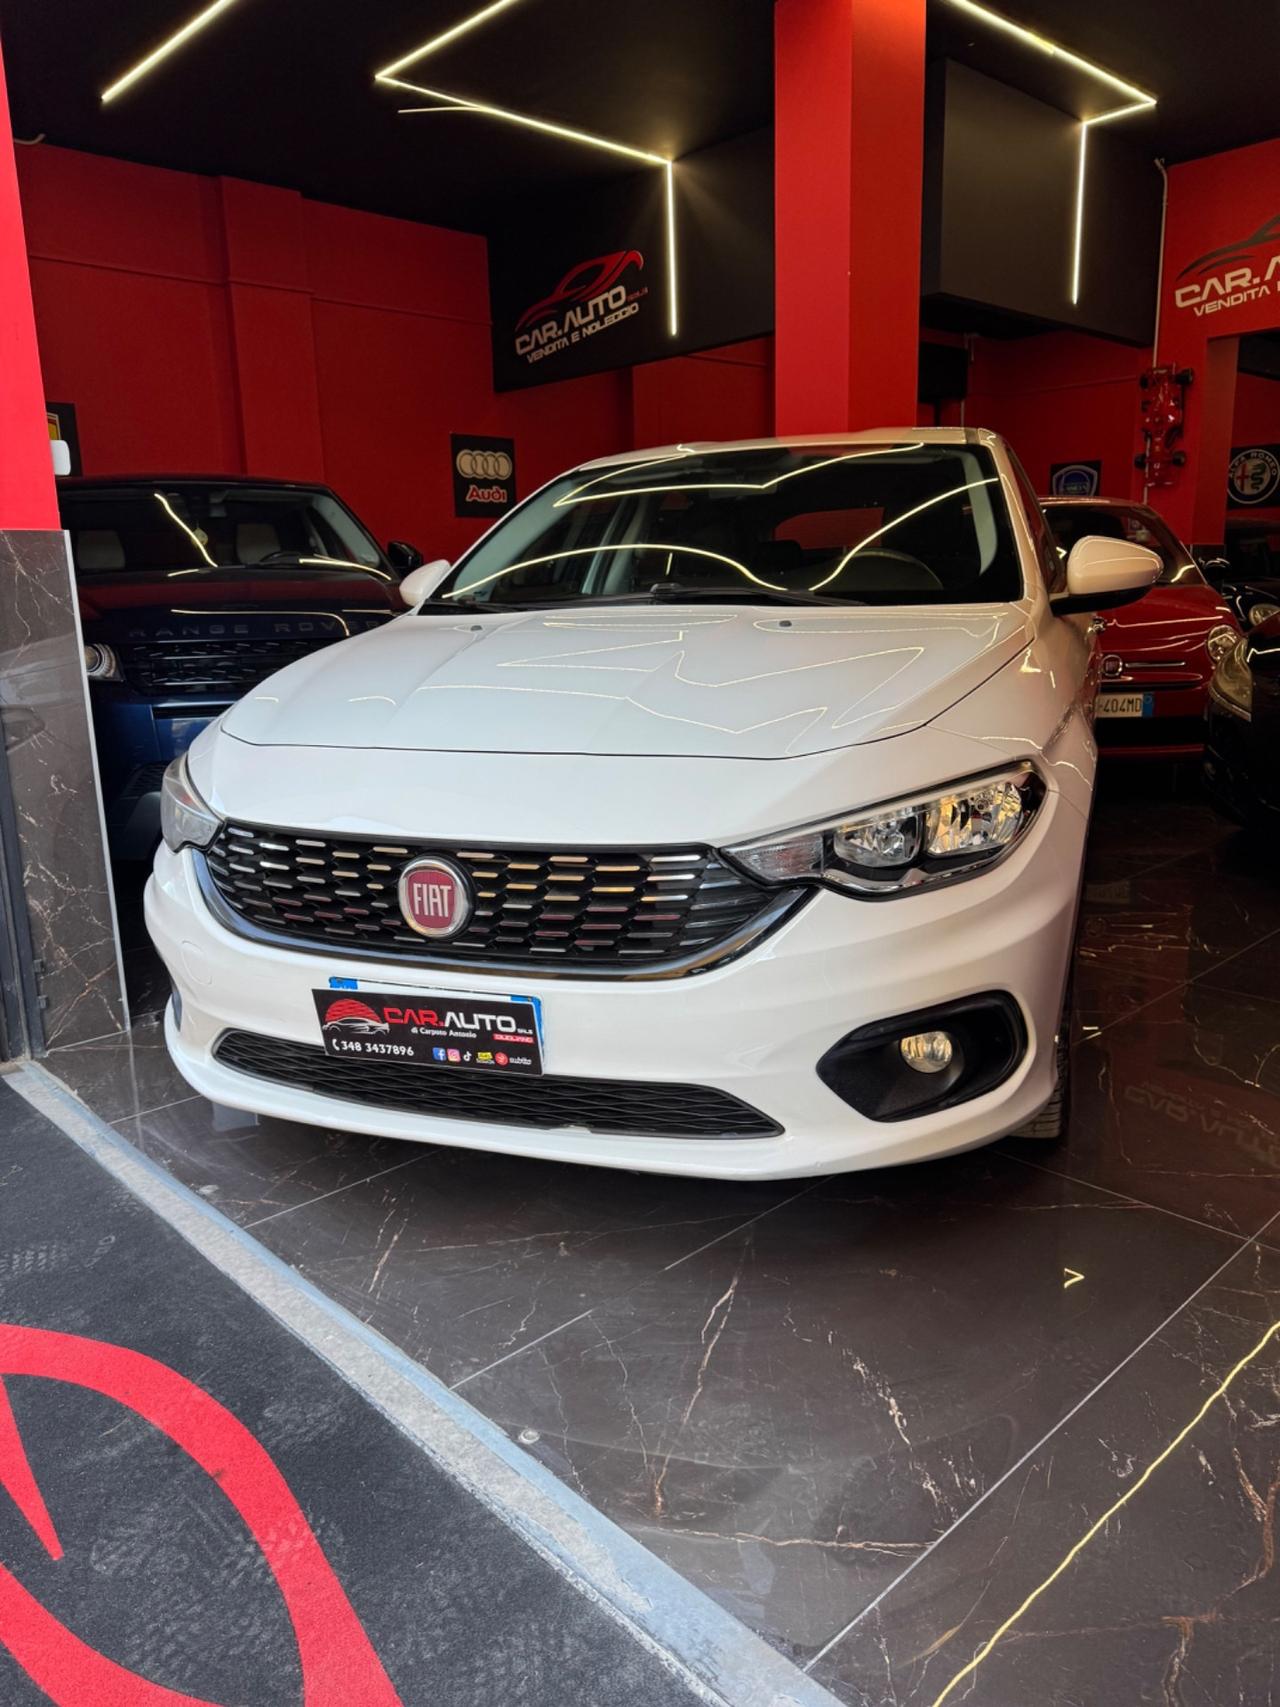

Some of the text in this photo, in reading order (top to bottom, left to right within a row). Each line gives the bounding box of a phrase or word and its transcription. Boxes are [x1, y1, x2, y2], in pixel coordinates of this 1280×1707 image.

[1193, 285, 1271, 317] VENDITA
[515, 285, 626, 355] CAR.AUTO
[527, 302, 639, 363] VENDITA E NOLEGGIO
[1250, 452, 1278, 477] ROMEO
[465, 484, 508, 503] Audi
[129, 624, 249, 637] RANGE
[412, 883, 452, 918] FIAT
[383, 1007, 516, 1033] CAR.AUTO
[341, 1041, 414, 1056] 348 3437896
